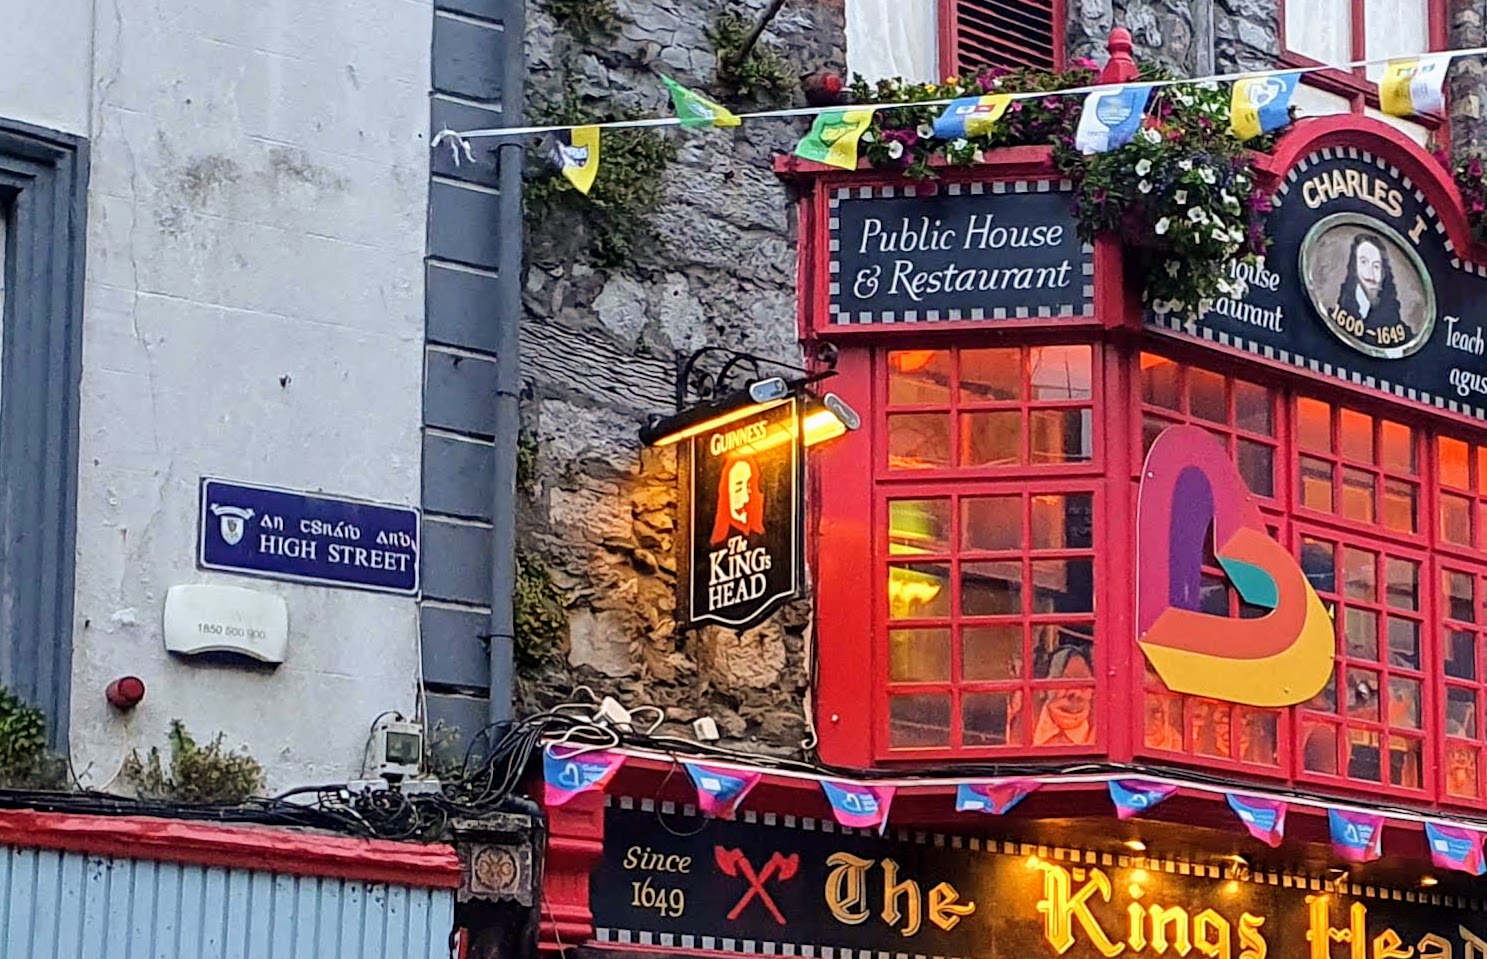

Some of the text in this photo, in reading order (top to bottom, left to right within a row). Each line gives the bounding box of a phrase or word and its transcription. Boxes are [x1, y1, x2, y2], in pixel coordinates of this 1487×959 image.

[1302, 168, 1428, 245] CHARLES I
[859, 214, 1063, 254] Public House
[853, 260, 1072, 301] & Restaurant
[1210, 296, 1283, 333] aurant
[1443, 315, 1485, 356] Teach
[710, 420, 768, 456] GUINNESS
[260, 534, 410, 572] HIGH STREET
[727, 535, 748, 554] The
[708, 573, 767, 611] HEAD
[198, 623, 223, 635] 1850
[623, 845, 692, 874] Since
[631, 876, 686, 918] 1649
[824, 851, 976, 938] The
